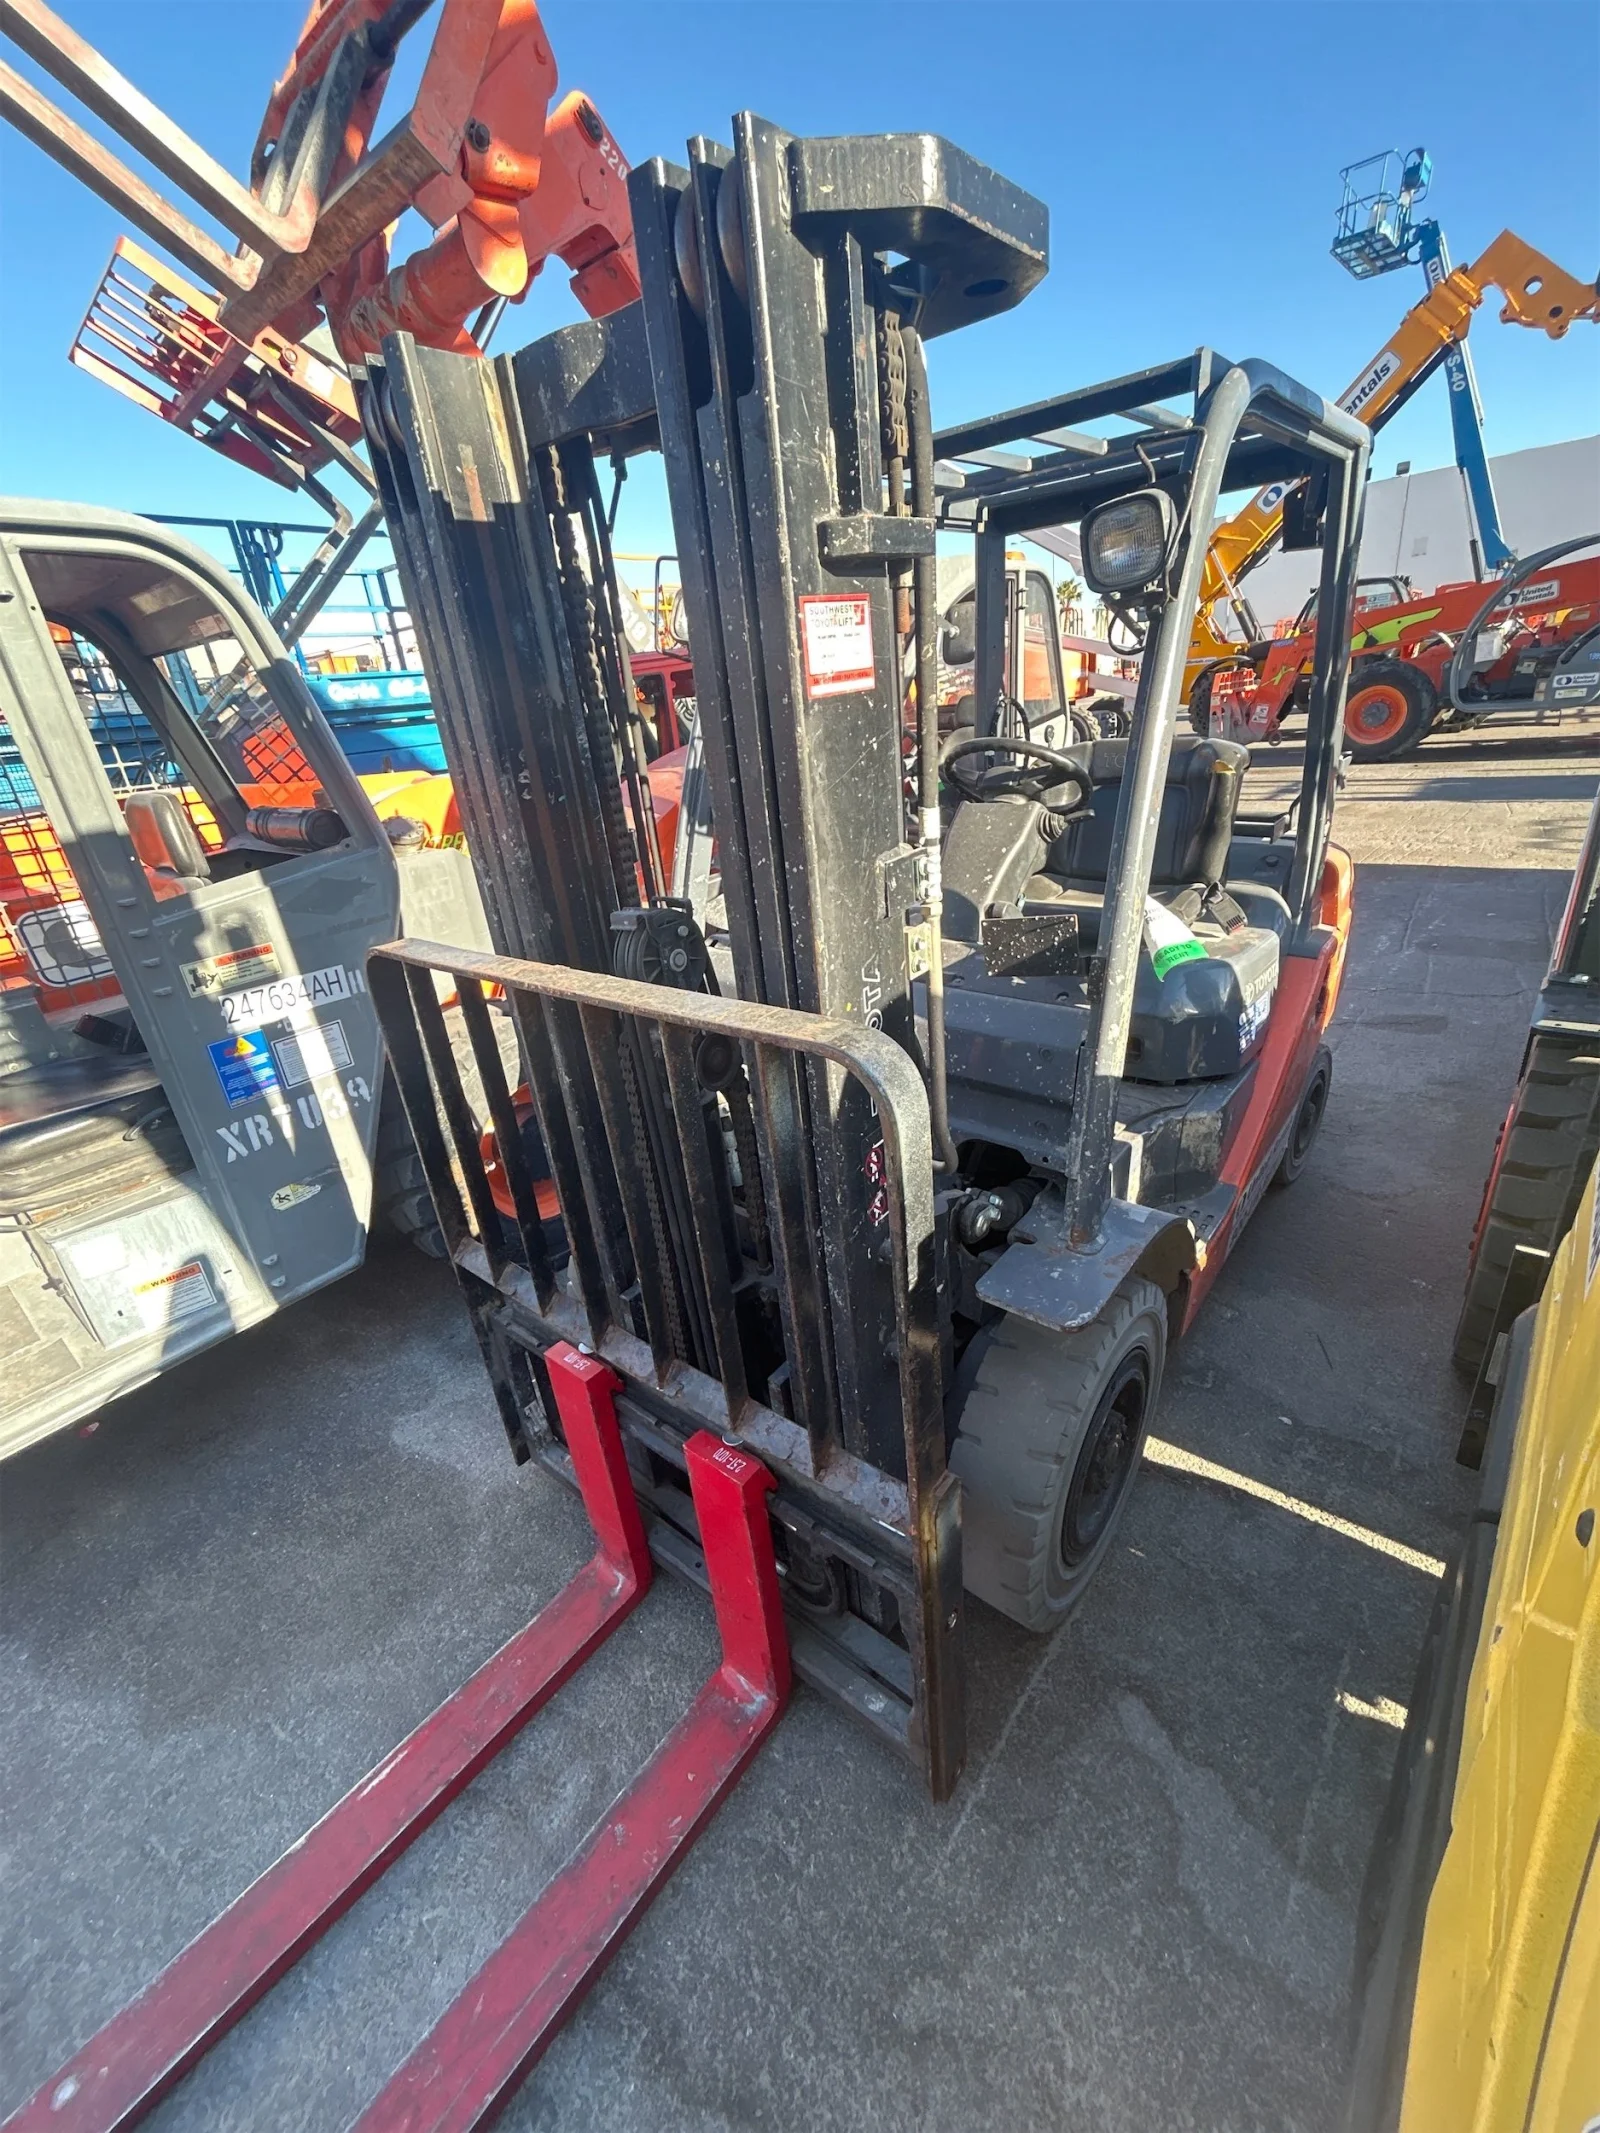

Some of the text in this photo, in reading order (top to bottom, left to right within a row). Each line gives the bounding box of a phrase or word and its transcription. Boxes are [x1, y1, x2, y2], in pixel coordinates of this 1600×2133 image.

[1343, 361, 1392, 417] entals
[1521, 591, 1555, 603] Rentals
[1522, 584, 1554, 596] United
[809, 604, 853, 616] SOUTHWEST
[227, 946, 270, 963] WARNING
[1155, 944, 1181, 963] READY
[1166, 951, 1190, 963] RENT
[221, 968, 344, 1024] 247634AH
[151, 1266, 197, 1287] WARNING
